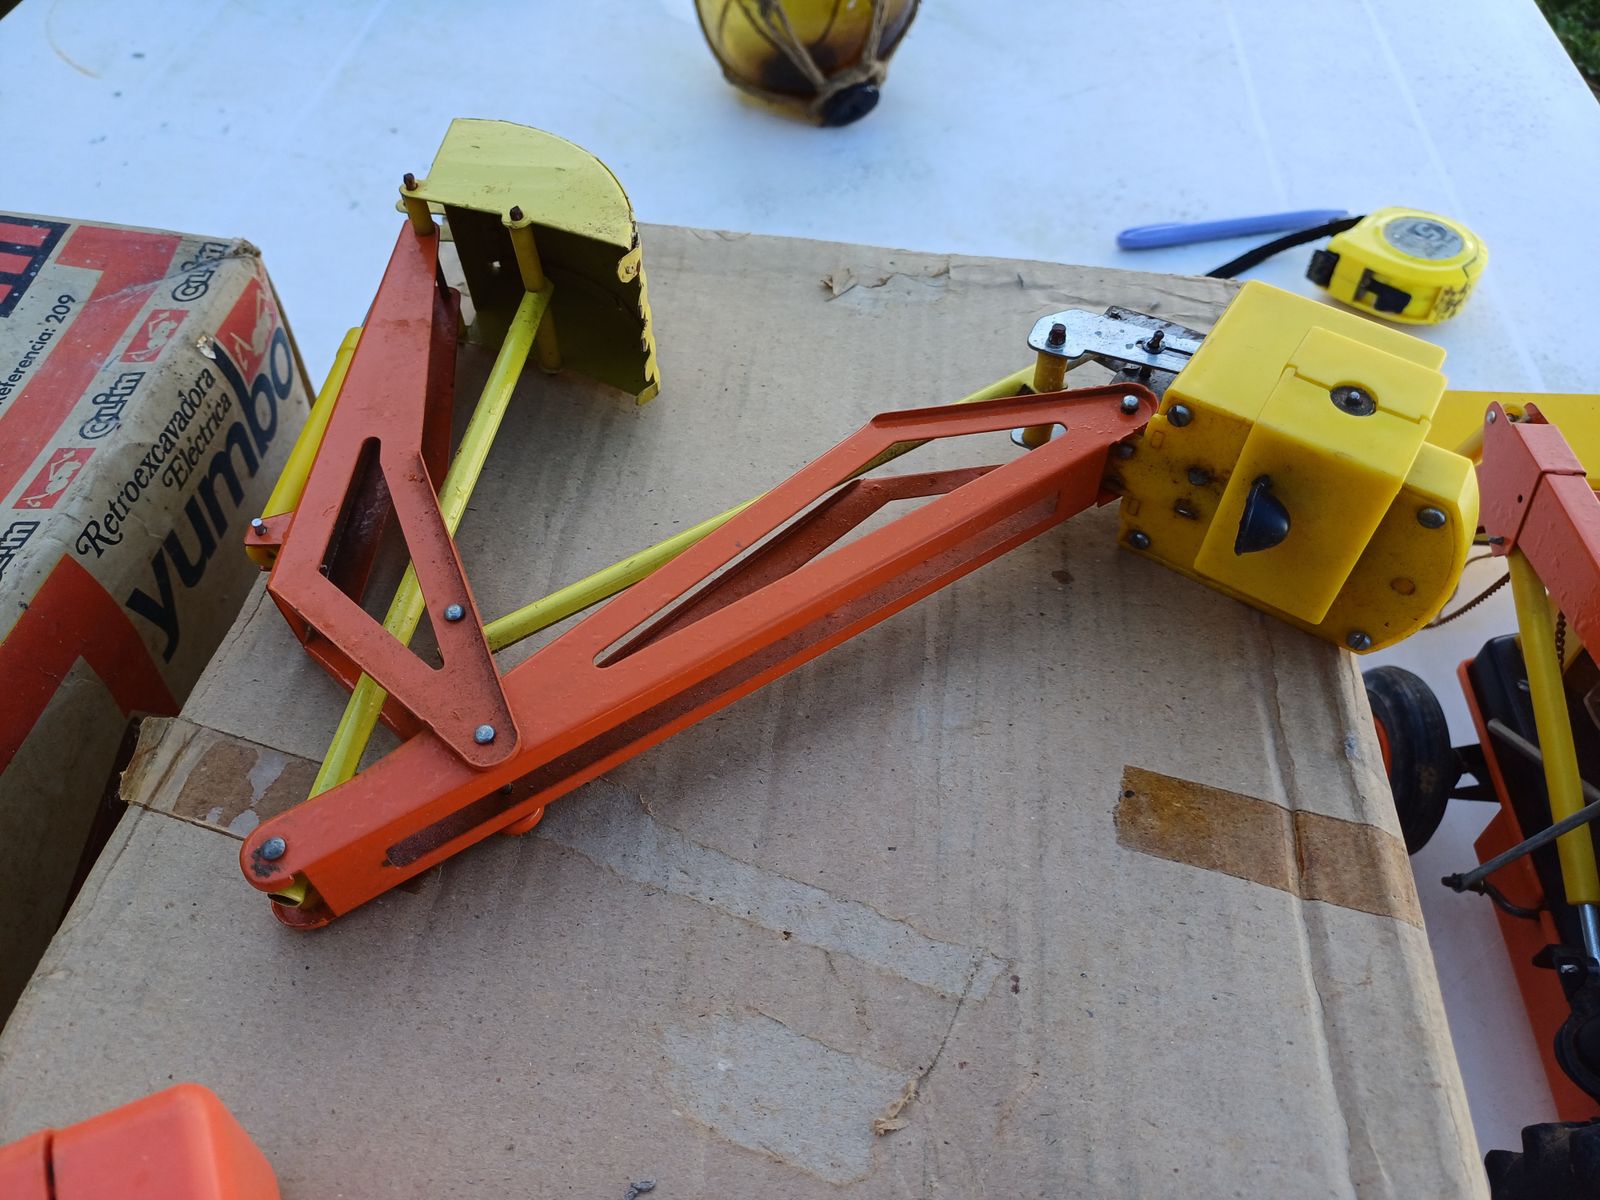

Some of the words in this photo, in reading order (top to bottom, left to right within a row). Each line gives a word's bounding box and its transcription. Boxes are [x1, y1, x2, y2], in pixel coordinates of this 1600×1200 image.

[45, 294, 76, 325] 209
[75, 367, 216, 558] Retroexcavadora
[125, 326, 294, 664] yumbo
